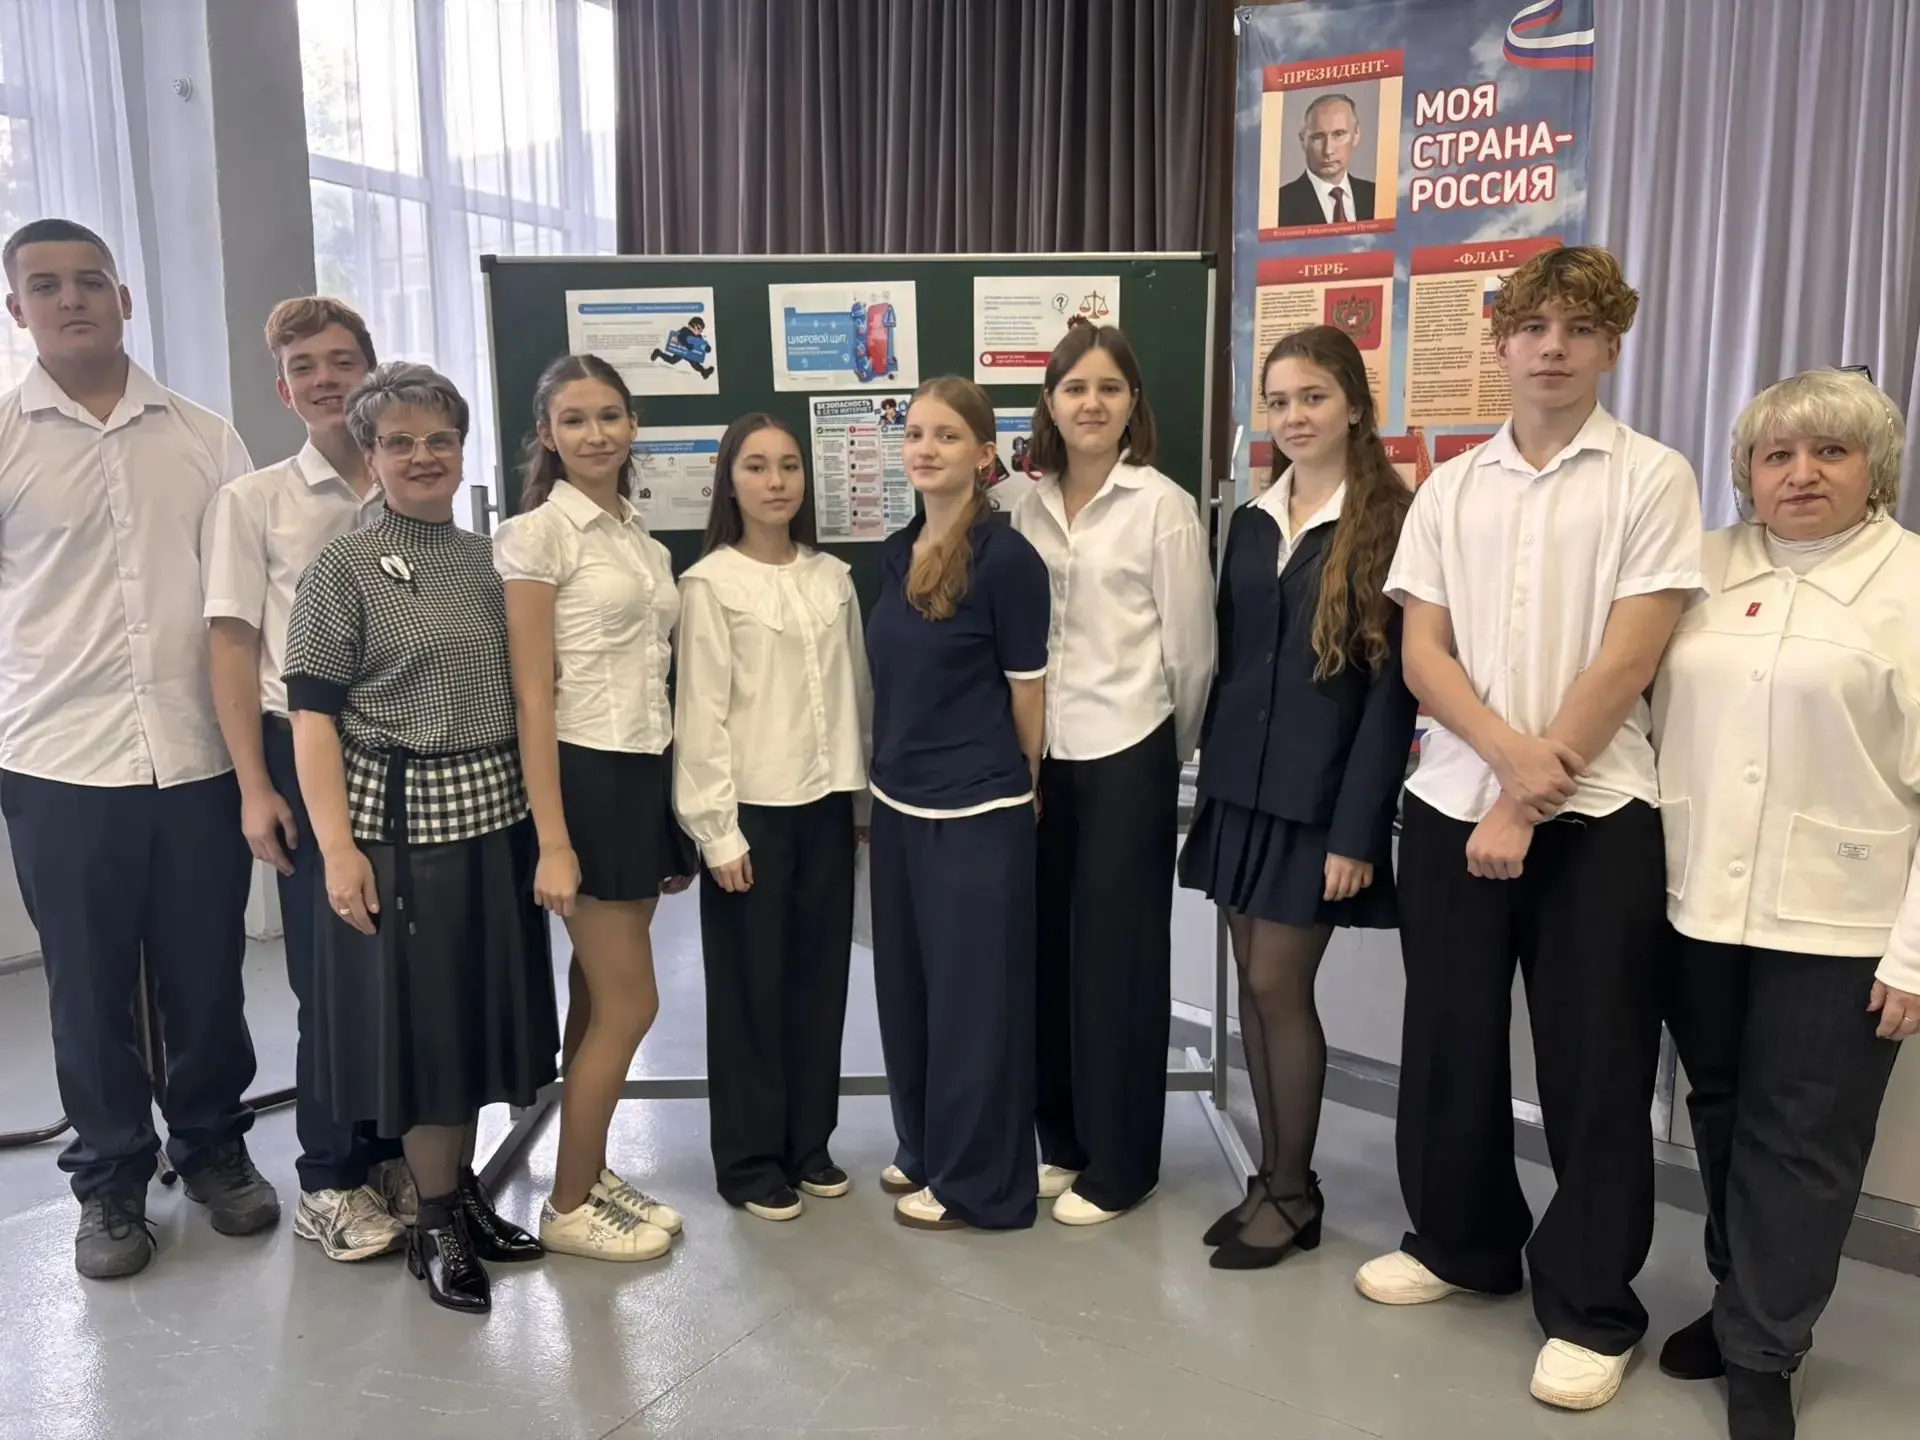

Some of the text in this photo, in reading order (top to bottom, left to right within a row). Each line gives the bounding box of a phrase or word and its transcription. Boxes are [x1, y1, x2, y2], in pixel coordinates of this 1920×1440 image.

[1277, 59, 1390, 85] -ПРЕЗИДЕНТ-
[1415, 84, 1495, 126] МОЯ
[1413, 121, 1573, 169] СТРАНА-
[1411, 164, 1554, 212] РОССИЯ
[1299, 262, 1349, 277] -ГЕРБ-
[1454, 248, 1514, 266] -ФЛАГ-
